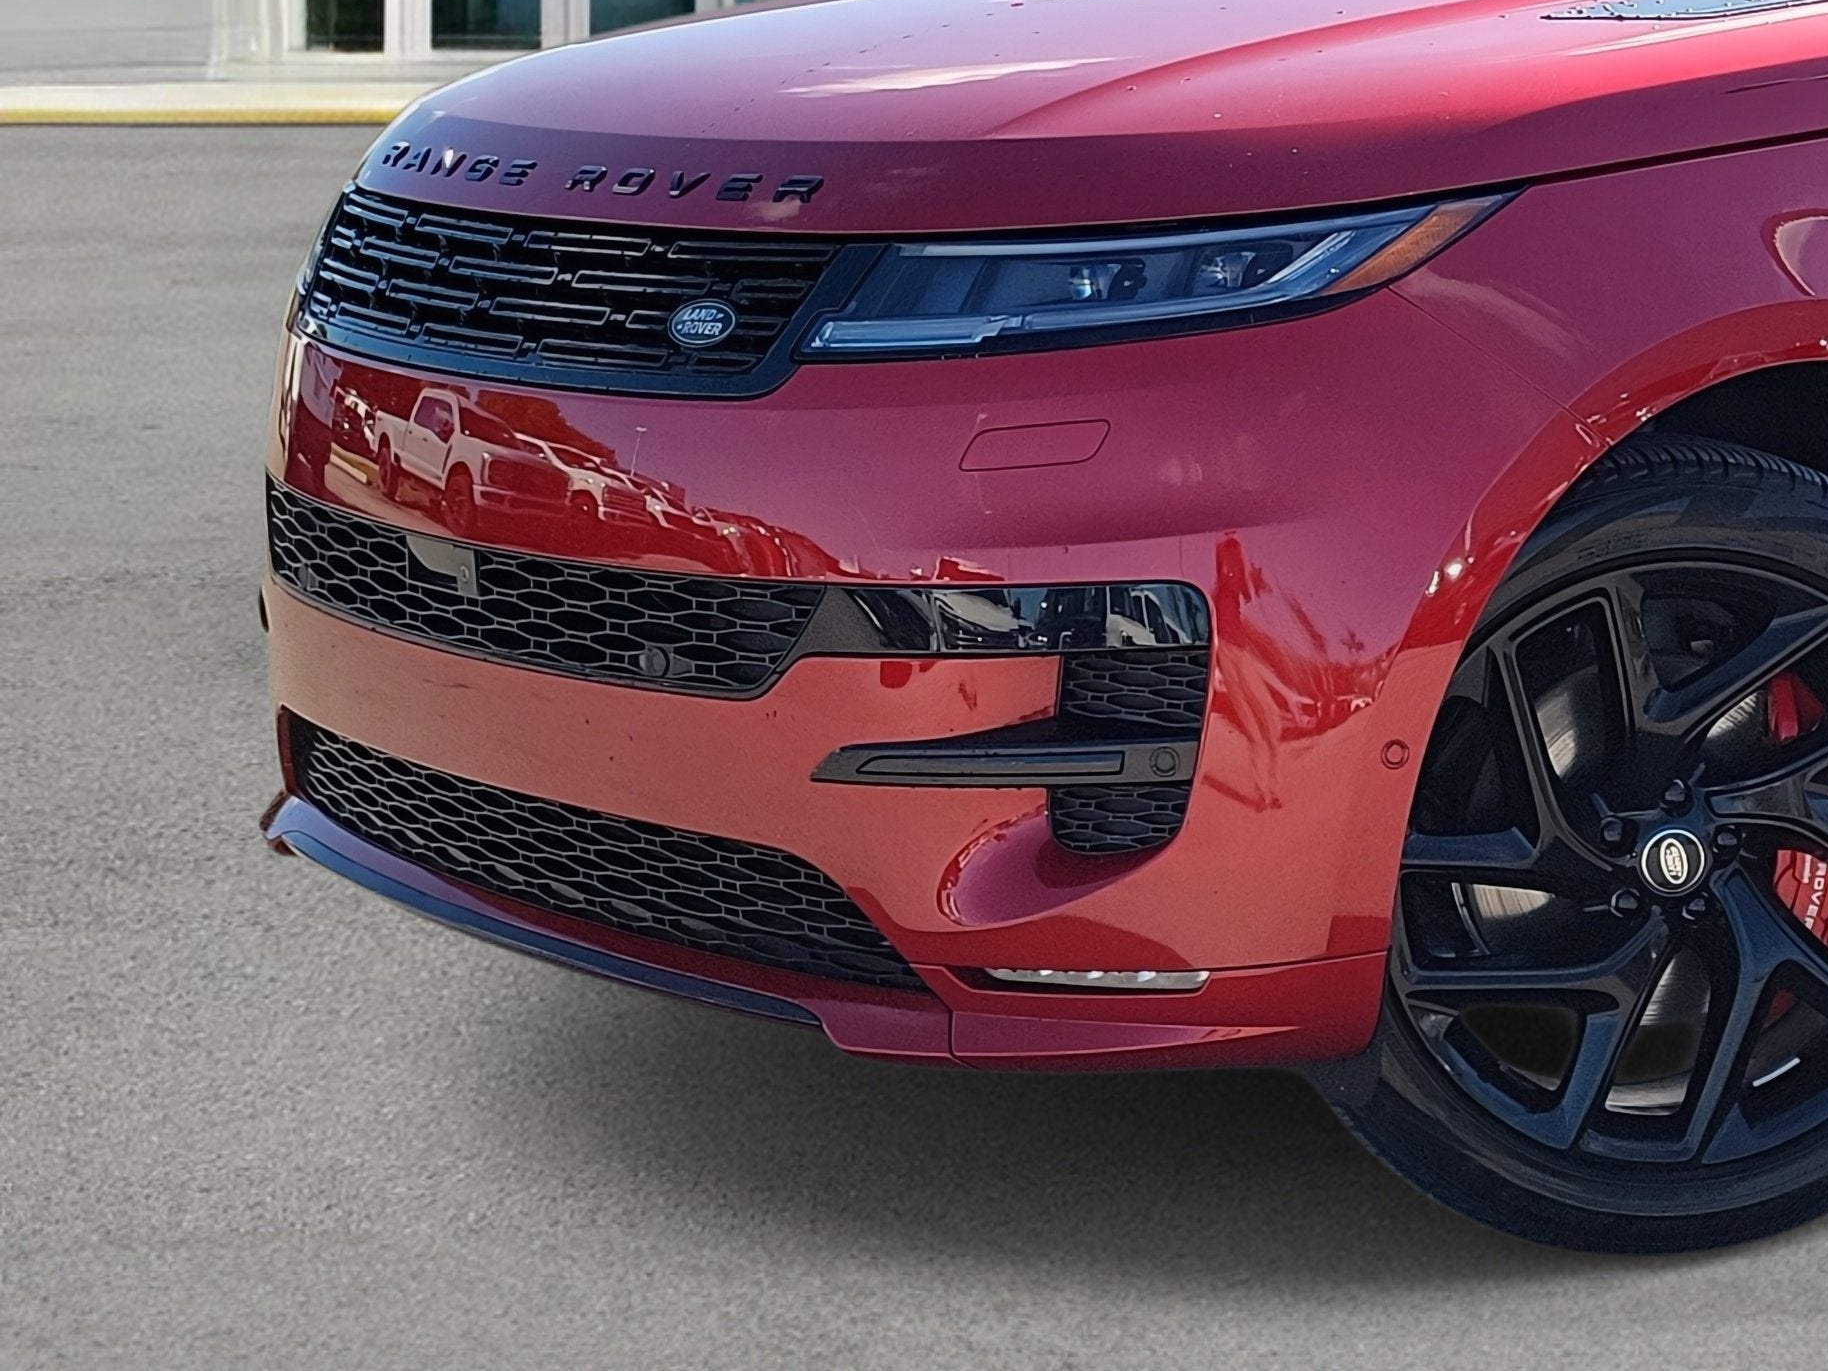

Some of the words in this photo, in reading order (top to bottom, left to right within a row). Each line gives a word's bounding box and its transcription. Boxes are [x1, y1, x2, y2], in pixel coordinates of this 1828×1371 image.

[382, 141, 538, 187] RANGE
[564, 165, 824, 203] ROVER
[681, 321, 723, 336] ROVER
[682, 308, 718, 321] LAND
[1803, 862, 1828, 931] ROVER
